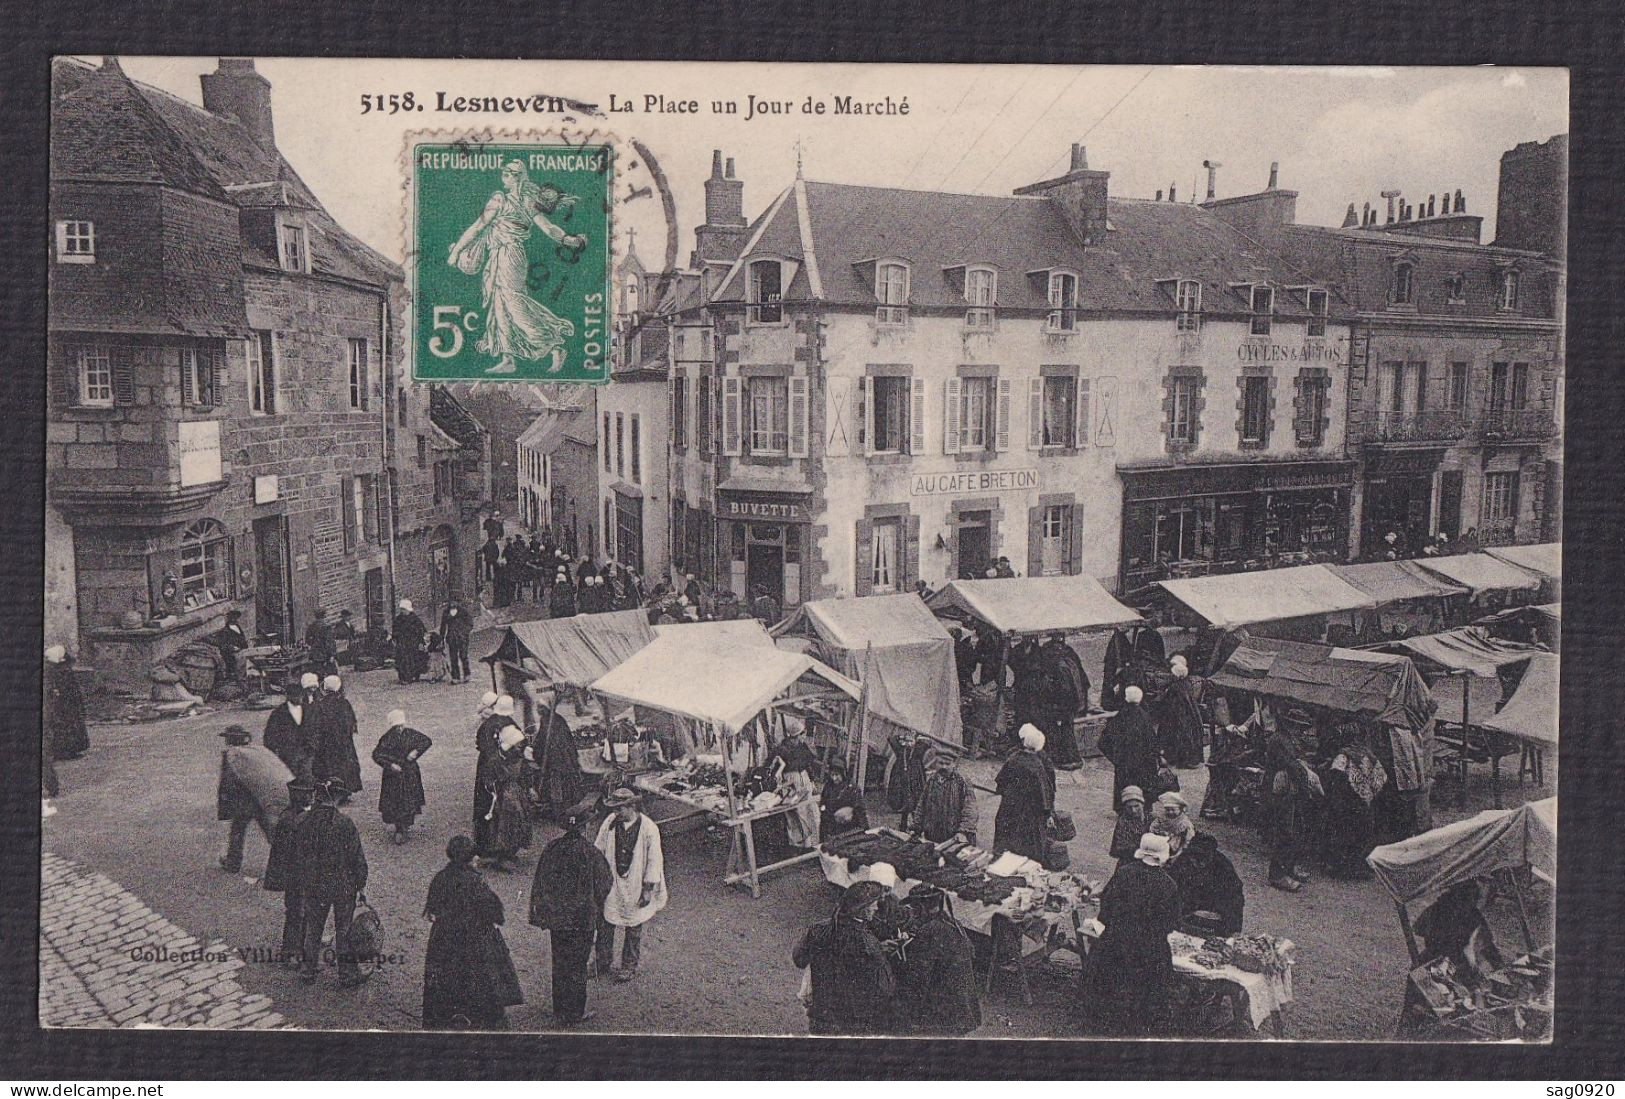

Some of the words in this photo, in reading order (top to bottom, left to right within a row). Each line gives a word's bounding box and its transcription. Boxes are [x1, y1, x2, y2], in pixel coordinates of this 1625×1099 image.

[583, 292, 603, 370] POSTES
[1238, 344, 1288, 361] CYCLES
[1300, 344, 1340, 361] AUTOS
[915, 477, 935, 493] AU
[980, 470, 1036, 489] BRETON
[730, 502, 799, 517] BUVETTE
